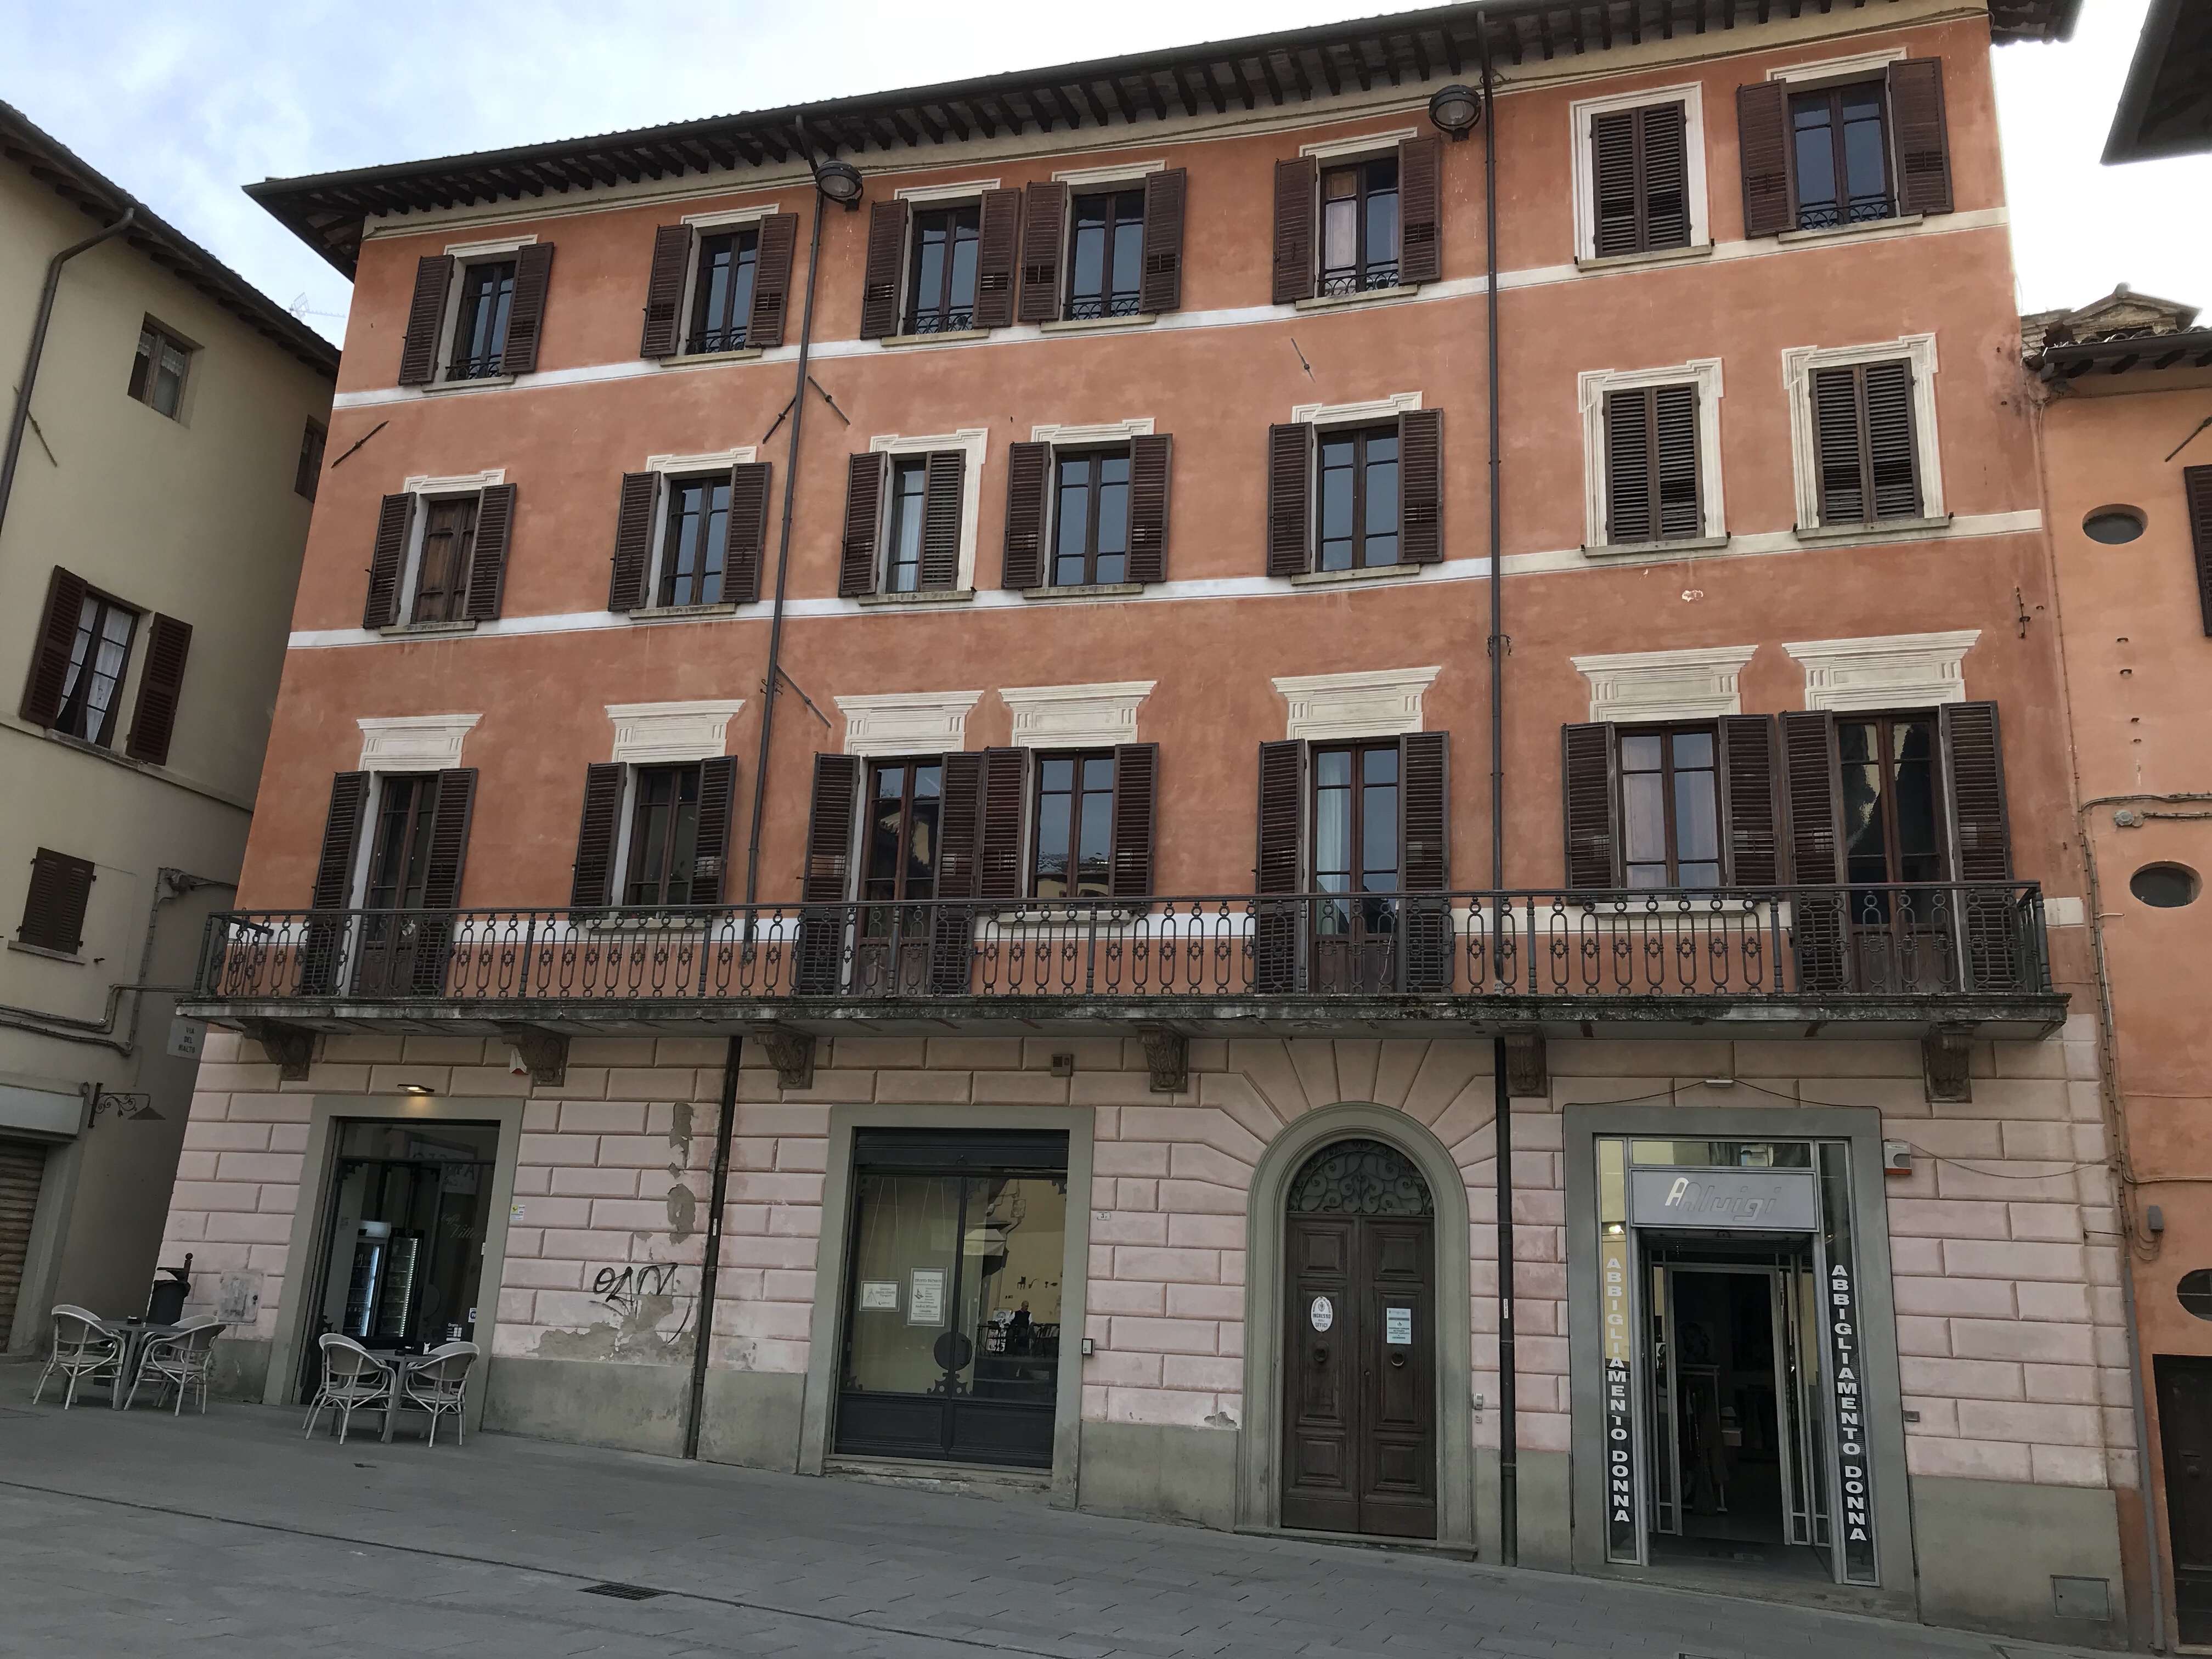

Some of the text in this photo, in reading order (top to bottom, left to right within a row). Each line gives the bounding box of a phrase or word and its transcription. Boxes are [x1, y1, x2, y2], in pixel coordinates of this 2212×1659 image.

[178, 1045, 195, 1054] RIALTO
[1606, 1258, 1630, 1522] ABBIGLIAMENTO DONNA
[1831, 1265, 1867, 1541] ABBIGLIAMENTO DONNA
